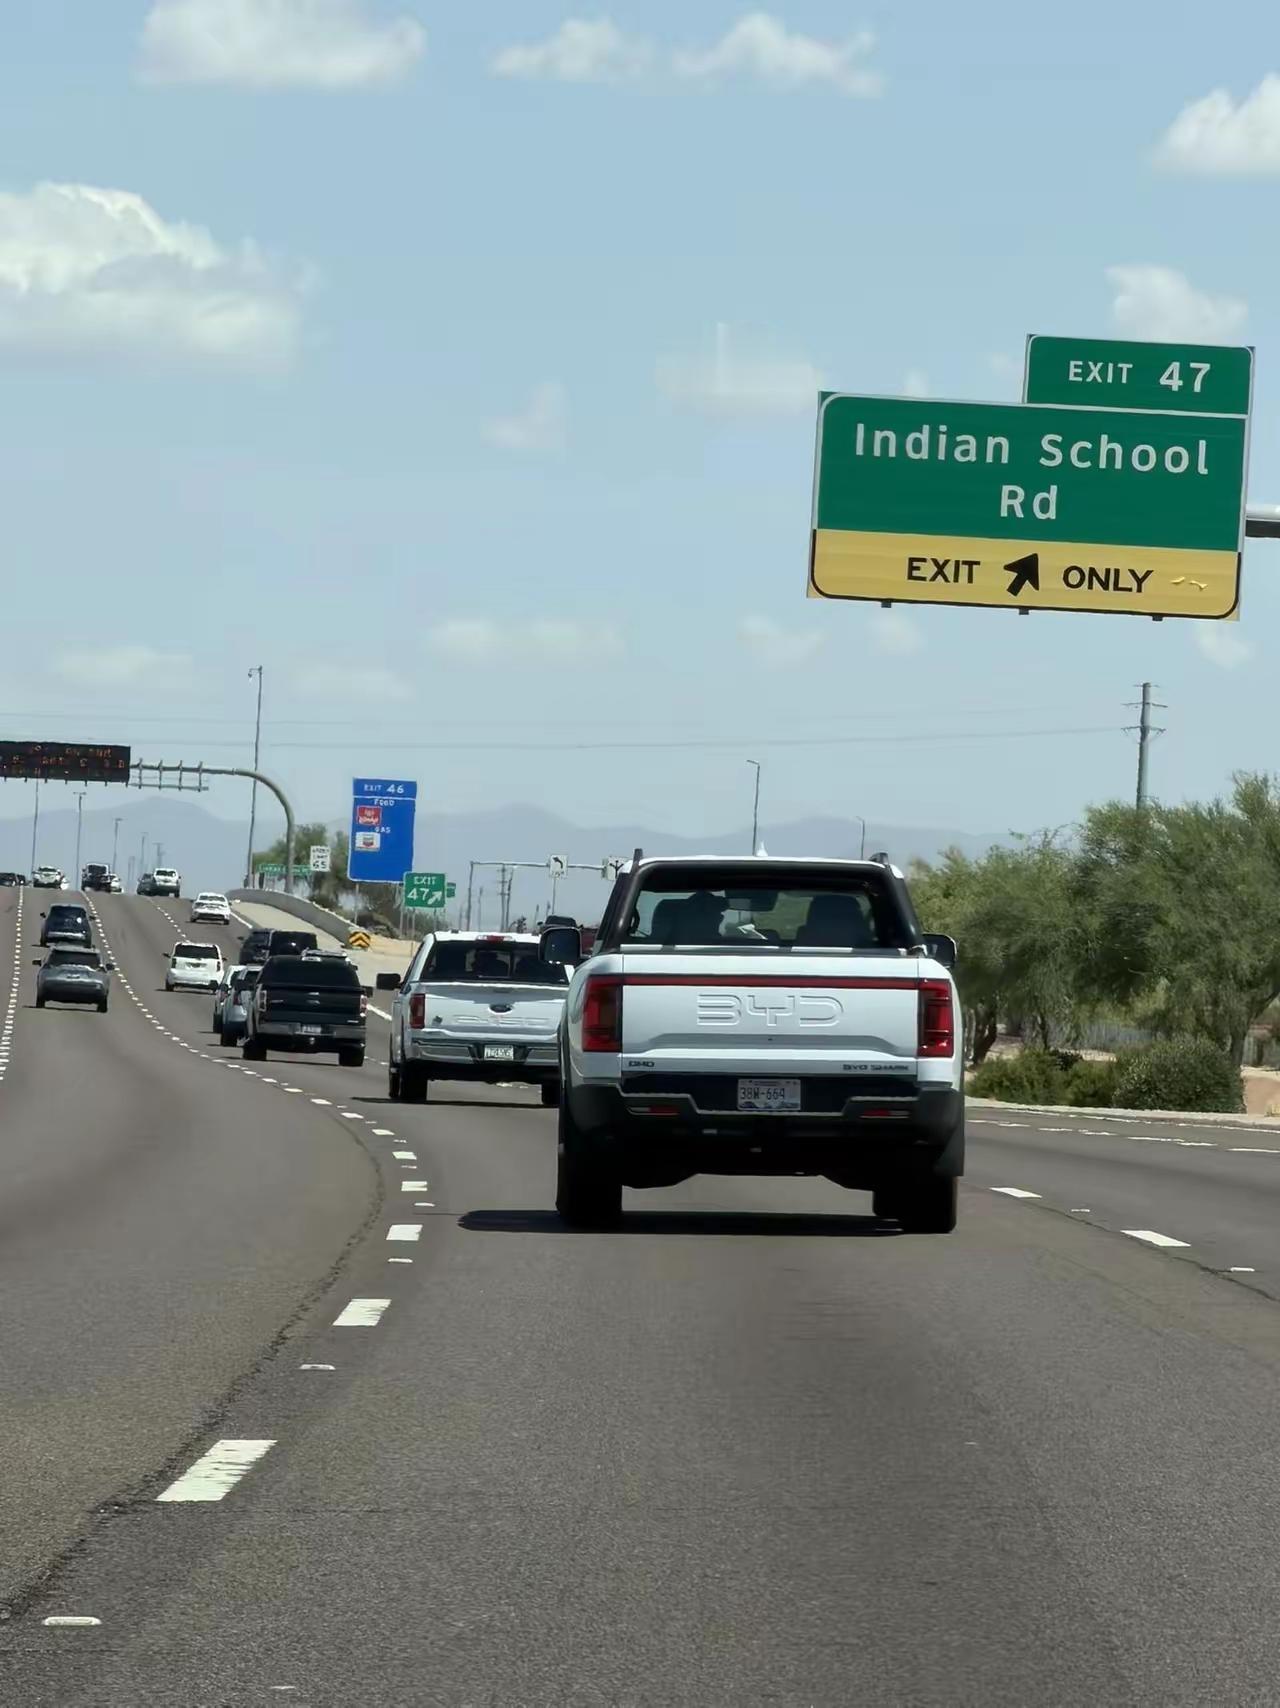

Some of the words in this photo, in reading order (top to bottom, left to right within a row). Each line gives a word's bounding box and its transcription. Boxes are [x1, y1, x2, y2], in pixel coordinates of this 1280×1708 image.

[1068, 360, 1133, 384] EXIT
[1159, 361, 1211, 393] 47
[855, 423, 1010, 464] Indian
[1039, 433, 1209, 475] School
[1000, 484, 1058, 520] Rd
[906, 556, 981, 584] EXIT
[1062, 565, 1154, 593] ONLY
[386, 784, 405, 794] 46
[407, 887, 430, 901] 47
[414, 876, 437, 885] EXIT
[697, 994, 844, 1027] BYD
